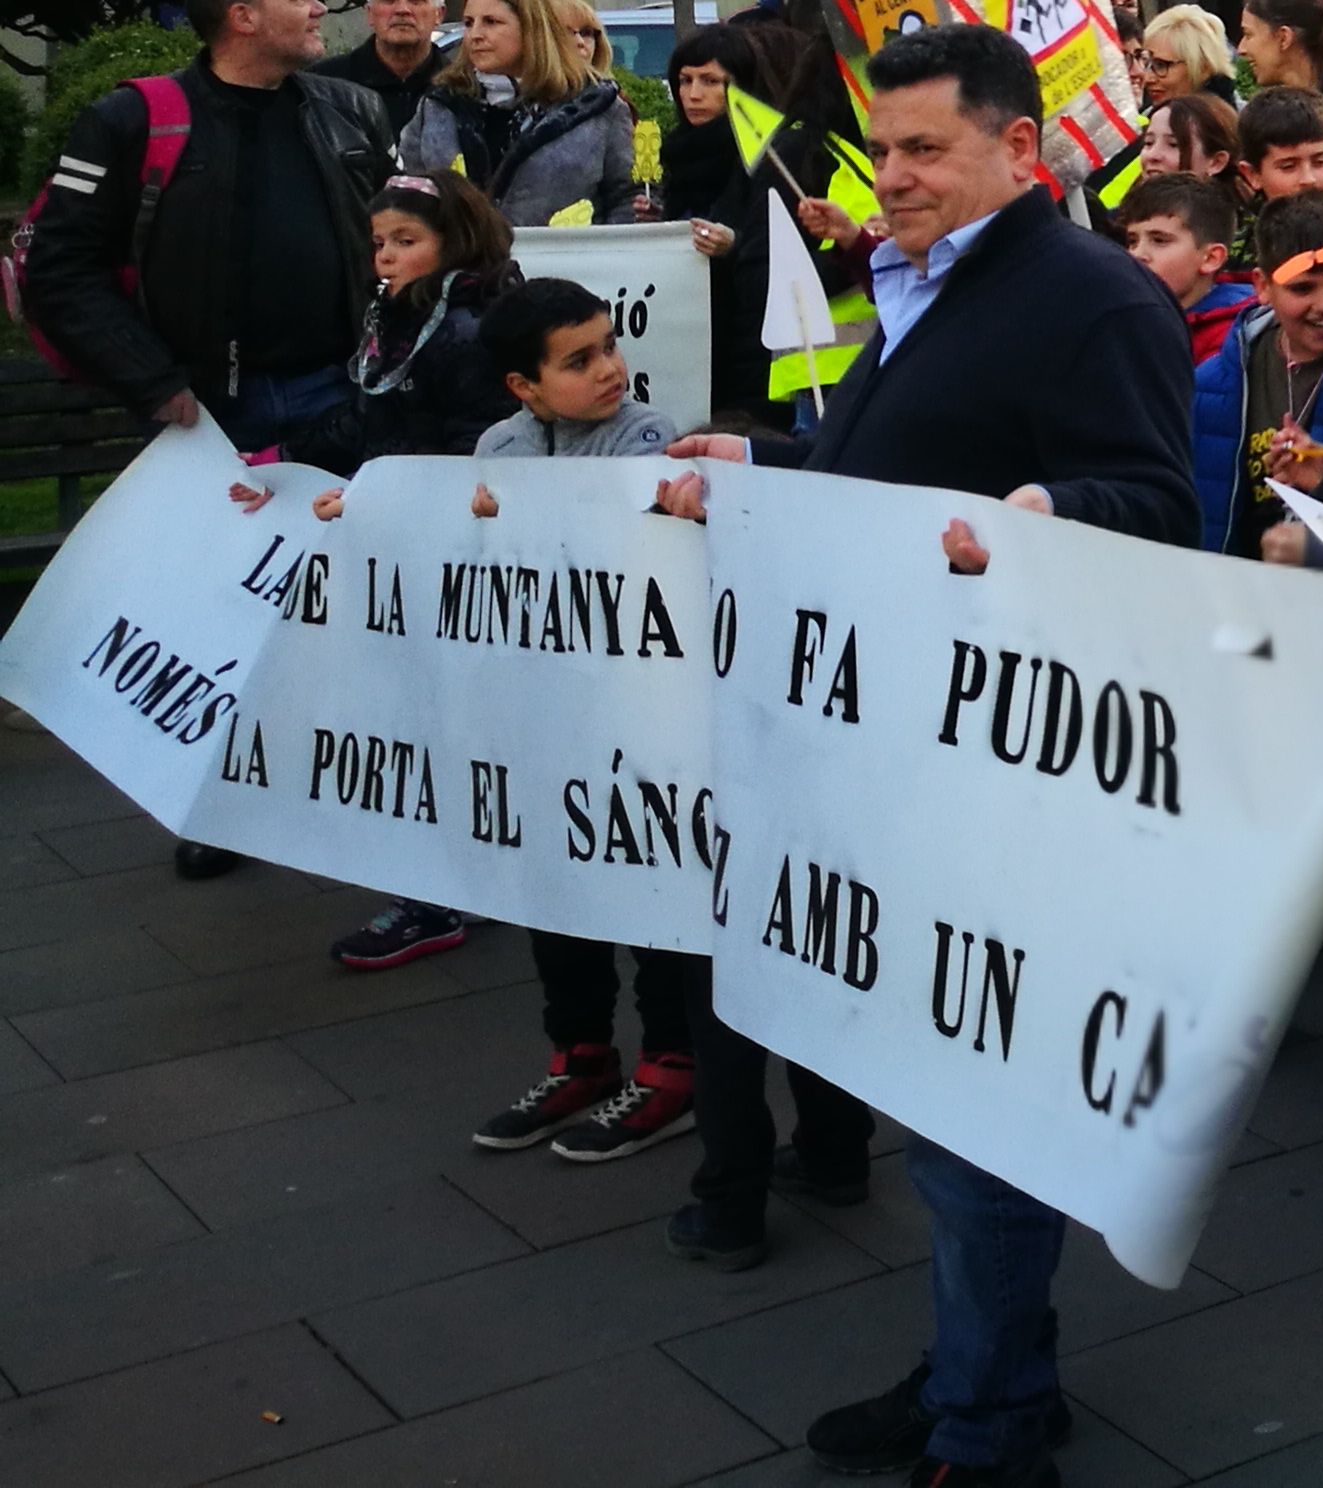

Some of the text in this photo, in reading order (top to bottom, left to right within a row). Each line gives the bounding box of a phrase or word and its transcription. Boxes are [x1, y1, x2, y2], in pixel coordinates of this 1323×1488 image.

[82, 616, 238, 745] NOMÉS
[221, 712, 269, 788] LA
[309, 728, 438, 824] PORTA
[470, 760, 522, 848] EL
[762, 854, 881, 992] AMB
[932, 922, 1026, 1063] UN
[366, 557, 406, 636] LA
[436, 562, 685, 658] MUNTANYA
[786, 608, 860, 724] FA
[939, 639, 1182, 815] PUDOR
